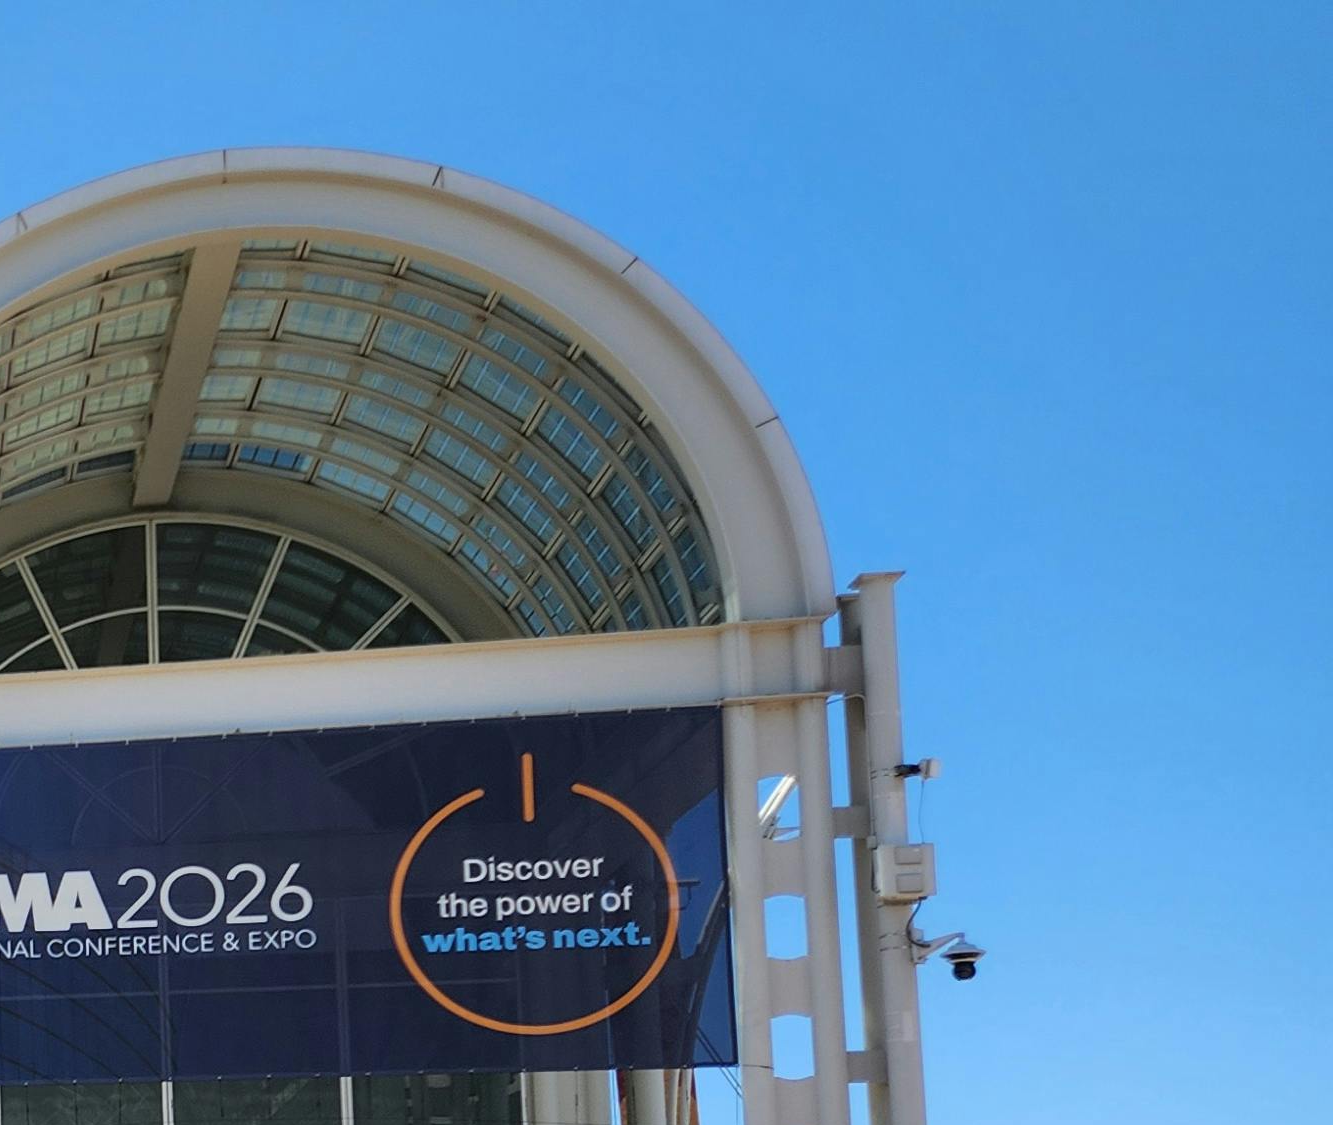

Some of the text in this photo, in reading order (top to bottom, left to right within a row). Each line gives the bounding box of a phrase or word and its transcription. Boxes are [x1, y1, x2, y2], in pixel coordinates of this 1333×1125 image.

[463, 855, 605, 883] Discover
[116, 862, 314, 930] 2026
[437, 884, 634, 921] the power of
[46, 932, 214, 959] CONFERENCE
[222, 931, 240, 953] &
[248, 929, 318, 952] EXPO
[421, 921, 652, 953] what's next.
